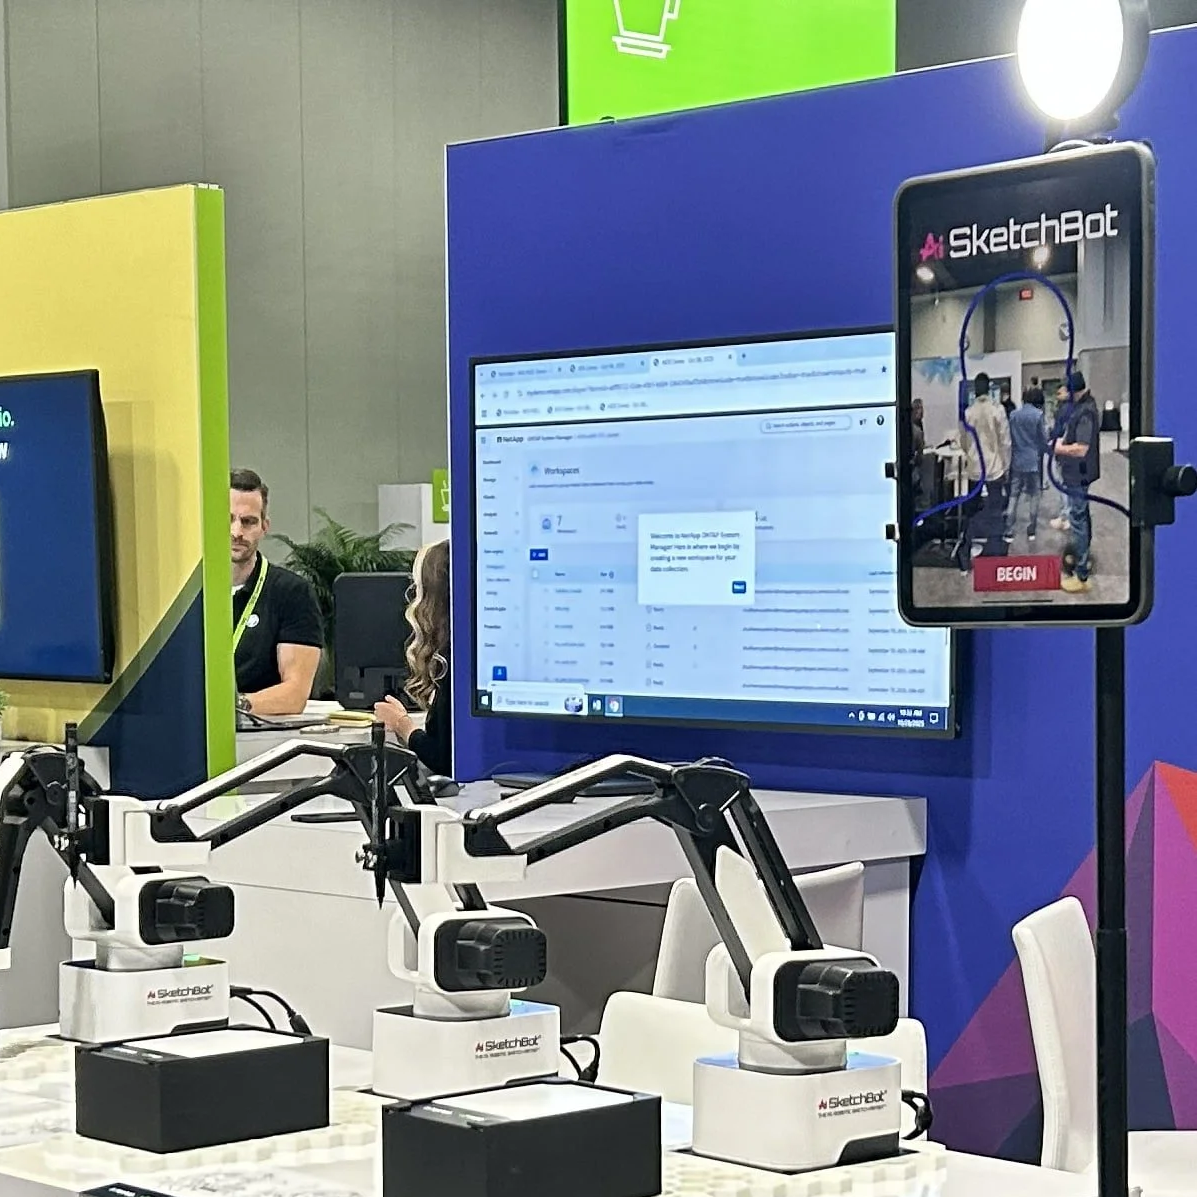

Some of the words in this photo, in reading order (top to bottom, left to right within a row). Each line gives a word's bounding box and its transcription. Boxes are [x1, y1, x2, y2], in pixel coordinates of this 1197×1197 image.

[949, 203, 1118, 258] SketchBot
[544, 467, 580, 476] Workspaces
[996, 566, 1037, 582] BEGIN
[157, 985, 213, 999] SketchBot
[485, 1036, 540, 1052] SketchBot
[828, 1091, 885, 1109] SketchBot
